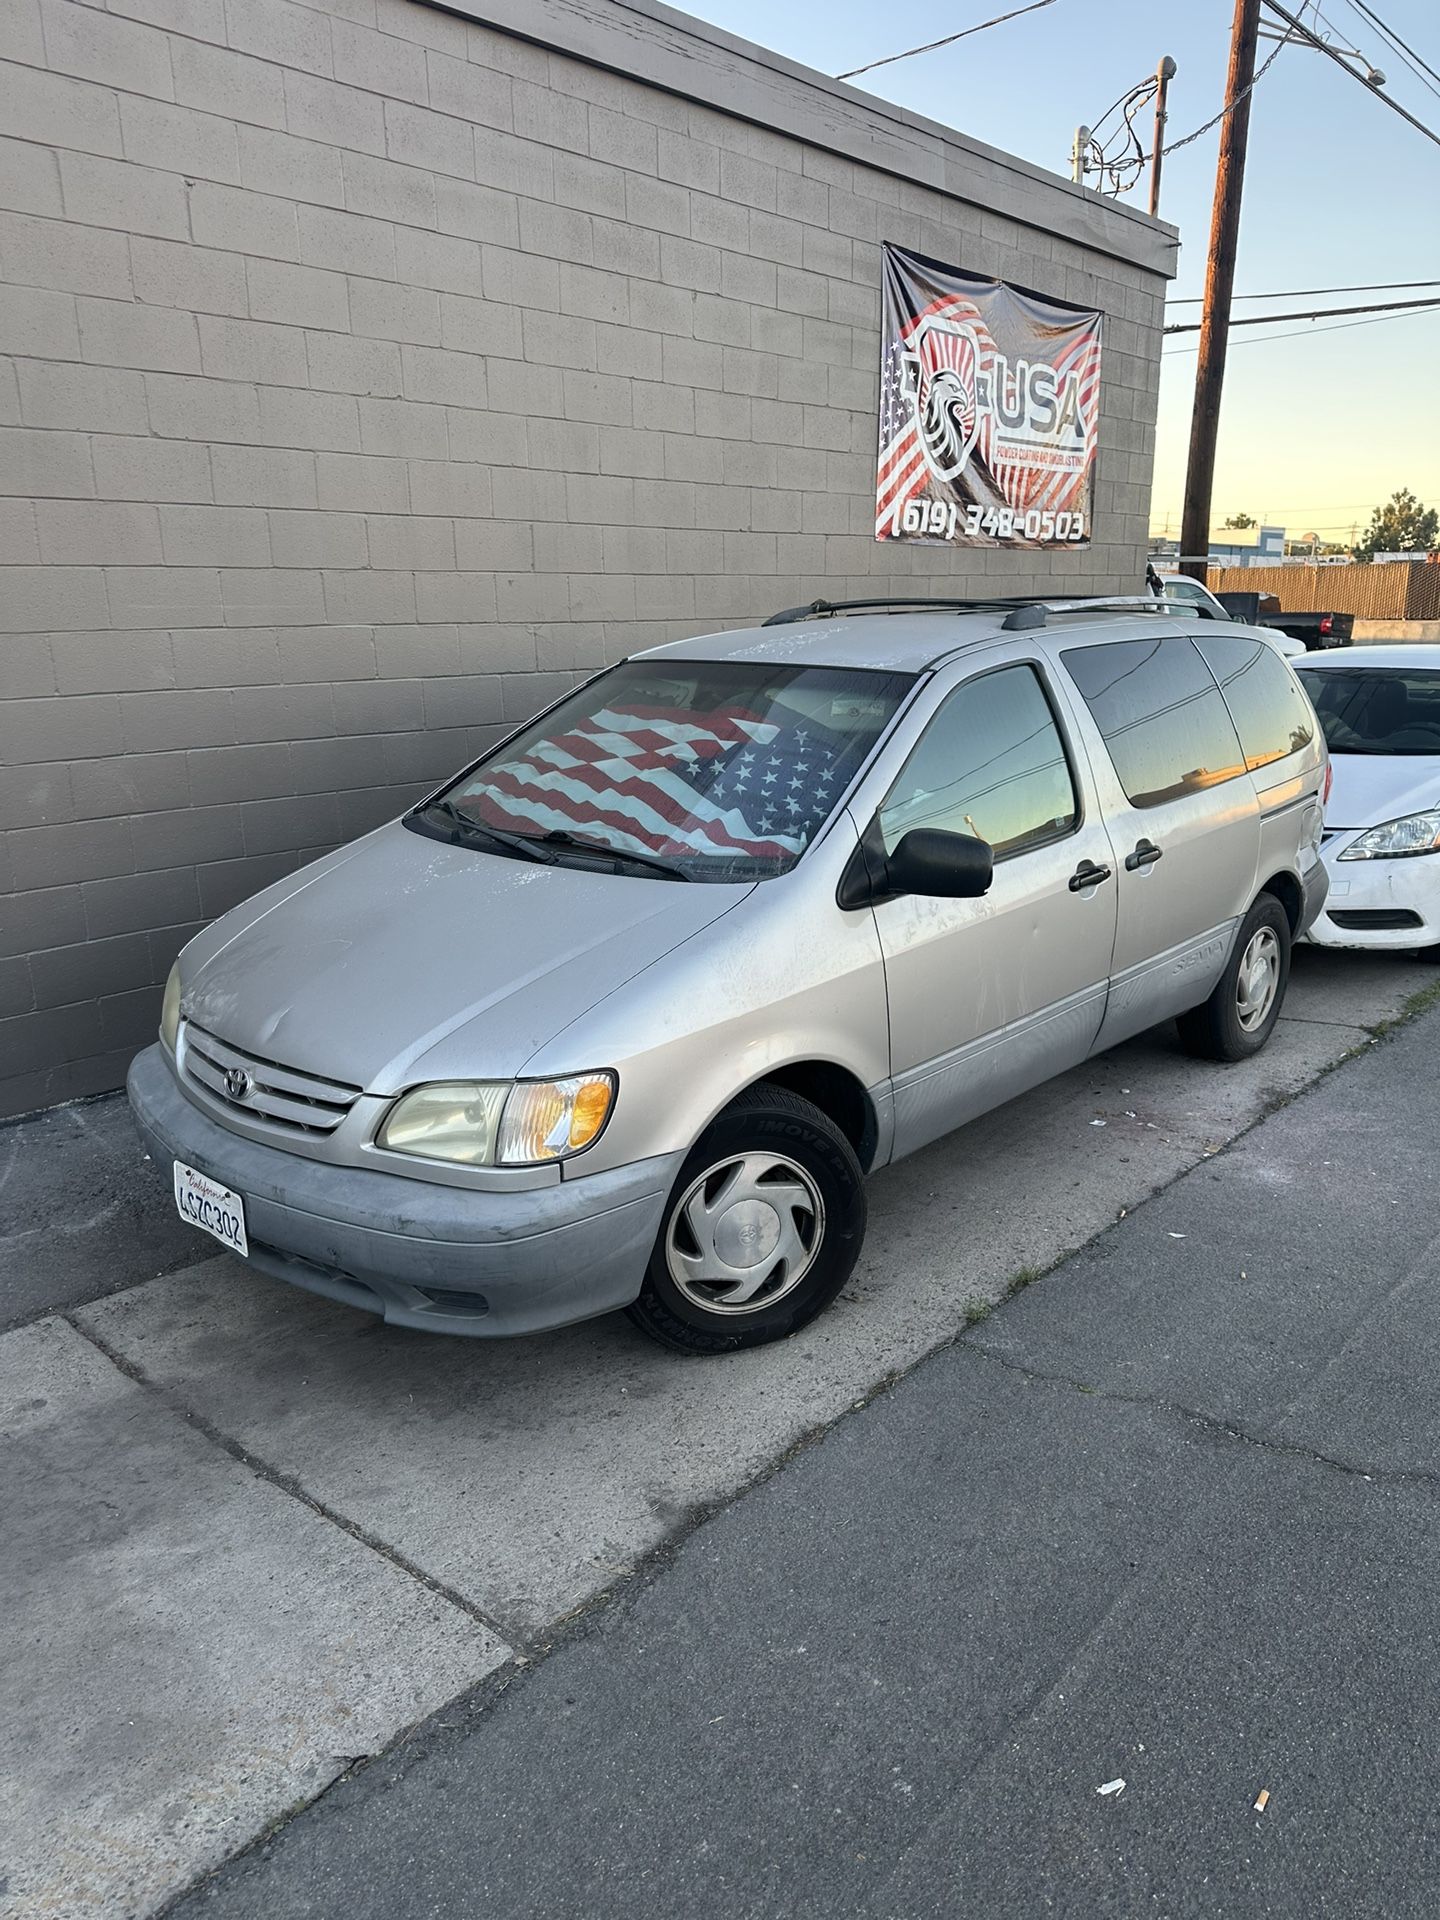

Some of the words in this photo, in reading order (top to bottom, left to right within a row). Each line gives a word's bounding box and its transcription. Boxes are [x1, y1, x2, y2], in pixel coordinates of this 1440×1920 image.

[995, 360, 1084, 438] USA
[893, 500, 955, 540] (619)
[966, 504, 1085, 541] 348-0503
[189, 1174, 228, 1202] California
[180, 1187, 242, 1247] 4SZC302
